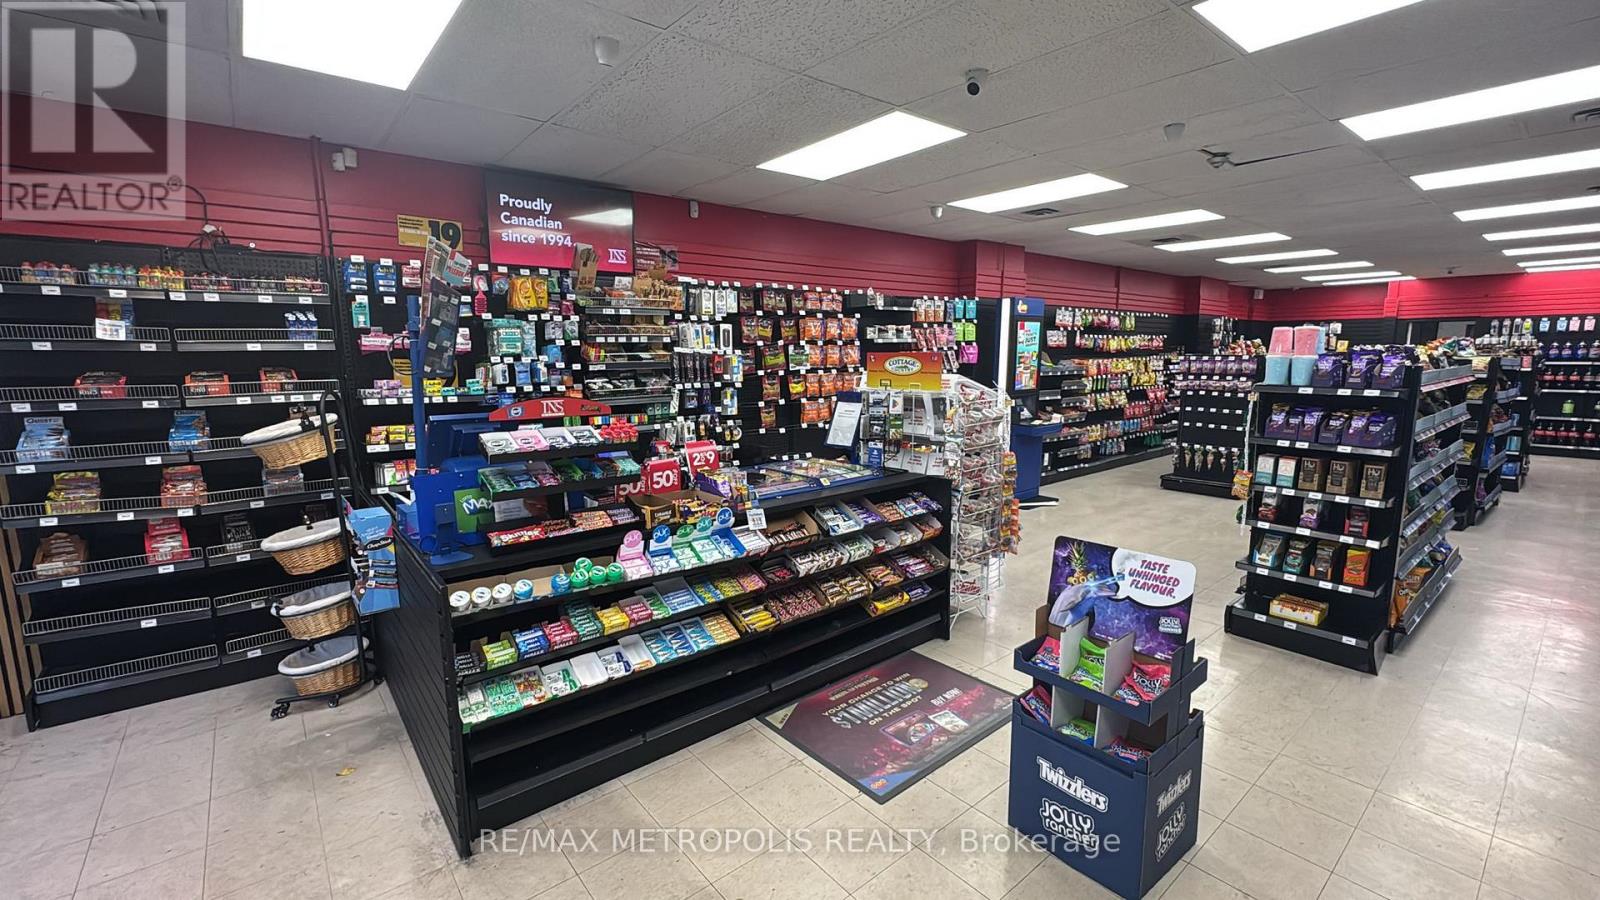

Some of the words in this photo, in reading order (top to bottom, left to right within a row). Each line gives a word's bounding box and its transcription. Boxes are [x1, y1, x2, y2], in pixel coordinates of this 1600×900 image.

[500, 193, 552, 215] Proudly
[500, 212, 562, 230] Canadian
[428, 220, 462, 251] 19
[501, 230, 536, 244] since
[540, 232, 577, 248] 1994.
[888, 358, 917, 367] COTTAGE
[652, 470, 673, 489] 50
[1139, 559, 1171, 574] TASTE
[1128, 567, 1181, 588] UNHINGED
[1129, 579, 1177, 599] FLAVOUR.
[821, 702, 849, 716] YOUR
[847, 686, 882, 704] CHANCE
[882, 680, 894, 688] TO
[893, 672, 911, 681] WIN
[868, 716, 883, 726] ON
[884, 706, 902, 718] THE
[900, 695, 923, 708] SPOT
[1038, 758, 1108, 811] Twizzlers
[1042, 800, 1093, 833] JOLLY
[1044, 819, 1099, 848] rancher
